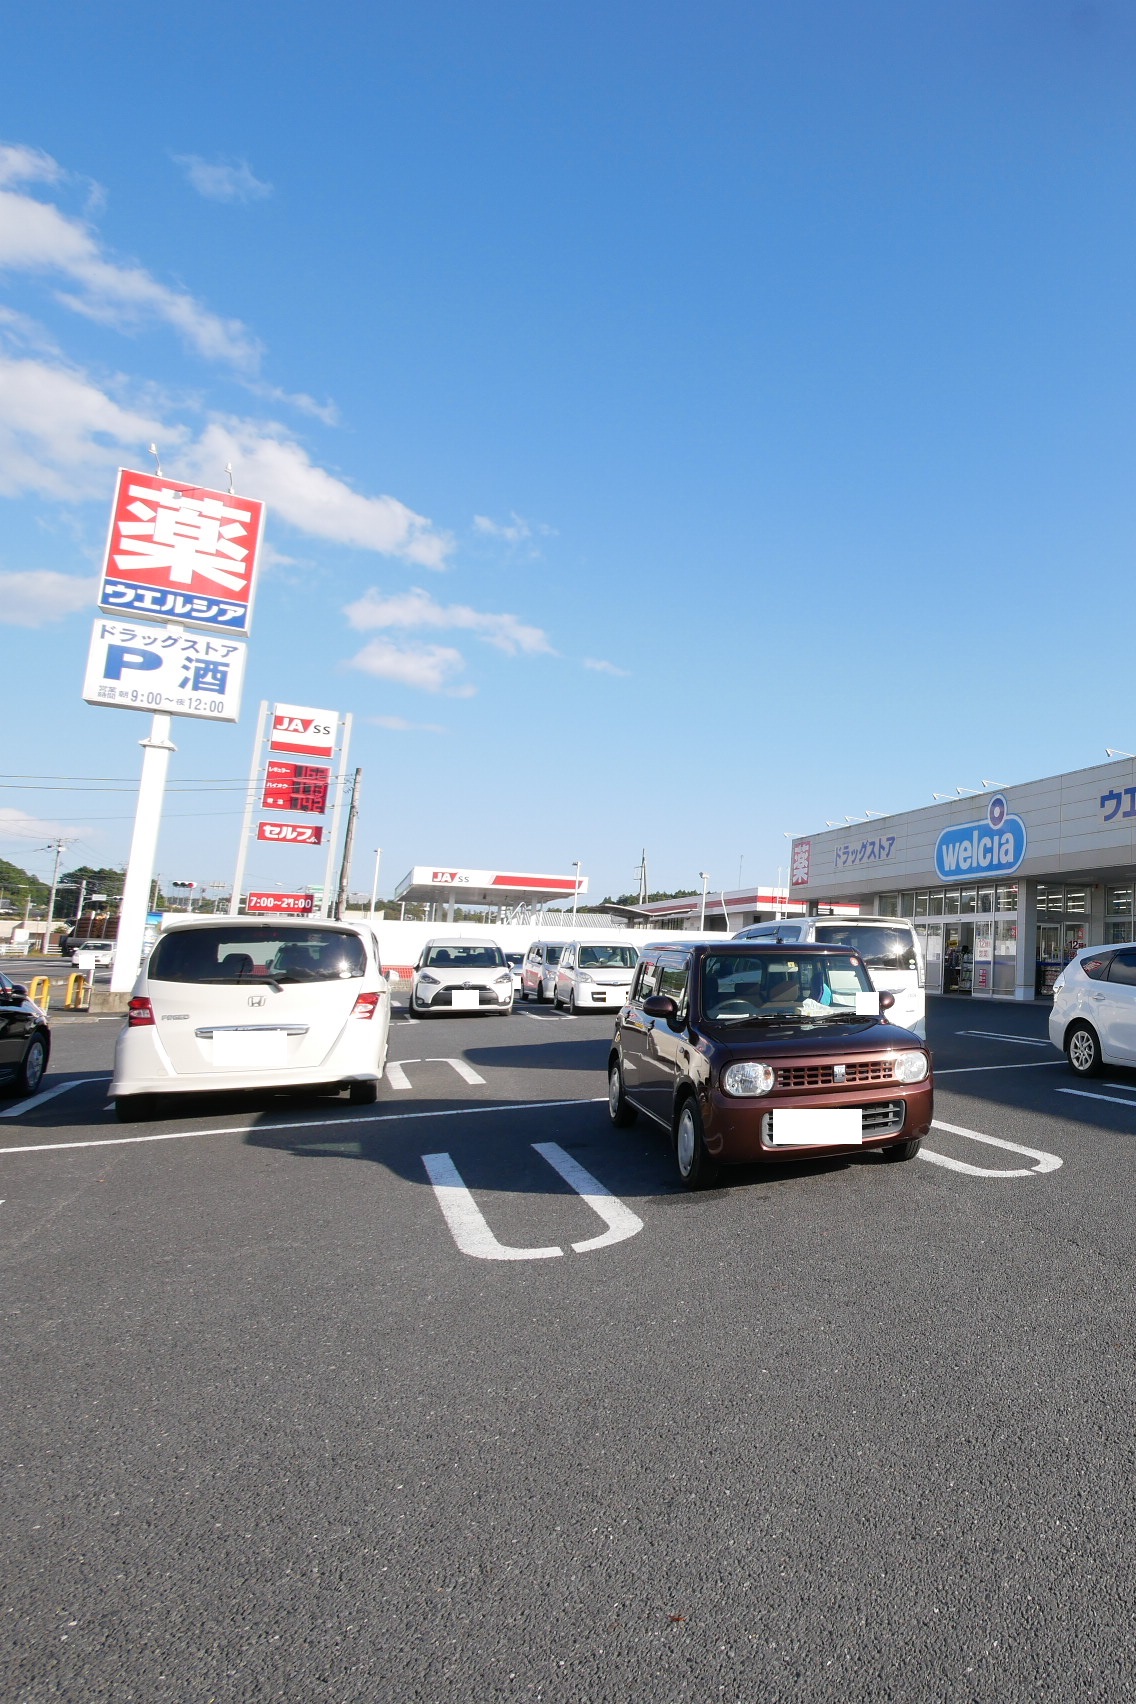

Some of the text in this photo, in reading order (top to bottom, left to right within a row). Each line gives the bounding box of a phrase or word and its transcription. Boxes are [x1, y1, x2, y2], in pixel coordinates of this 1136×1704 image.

[113, 484, 252, 592] 薬
[104, 584, 246, 622] ウエルシア
[100, 623, 240, 659] ドラッグストア
[103, 643, 231, 696] P 酒
[275, 716, 306, 734] JA
[262, 824, 313, 841] セルフ
[941, 829, 1015, 872] welcia
[834, 835, 897, 868] ドラッグストア
[432, 871, 453, 883] JA
